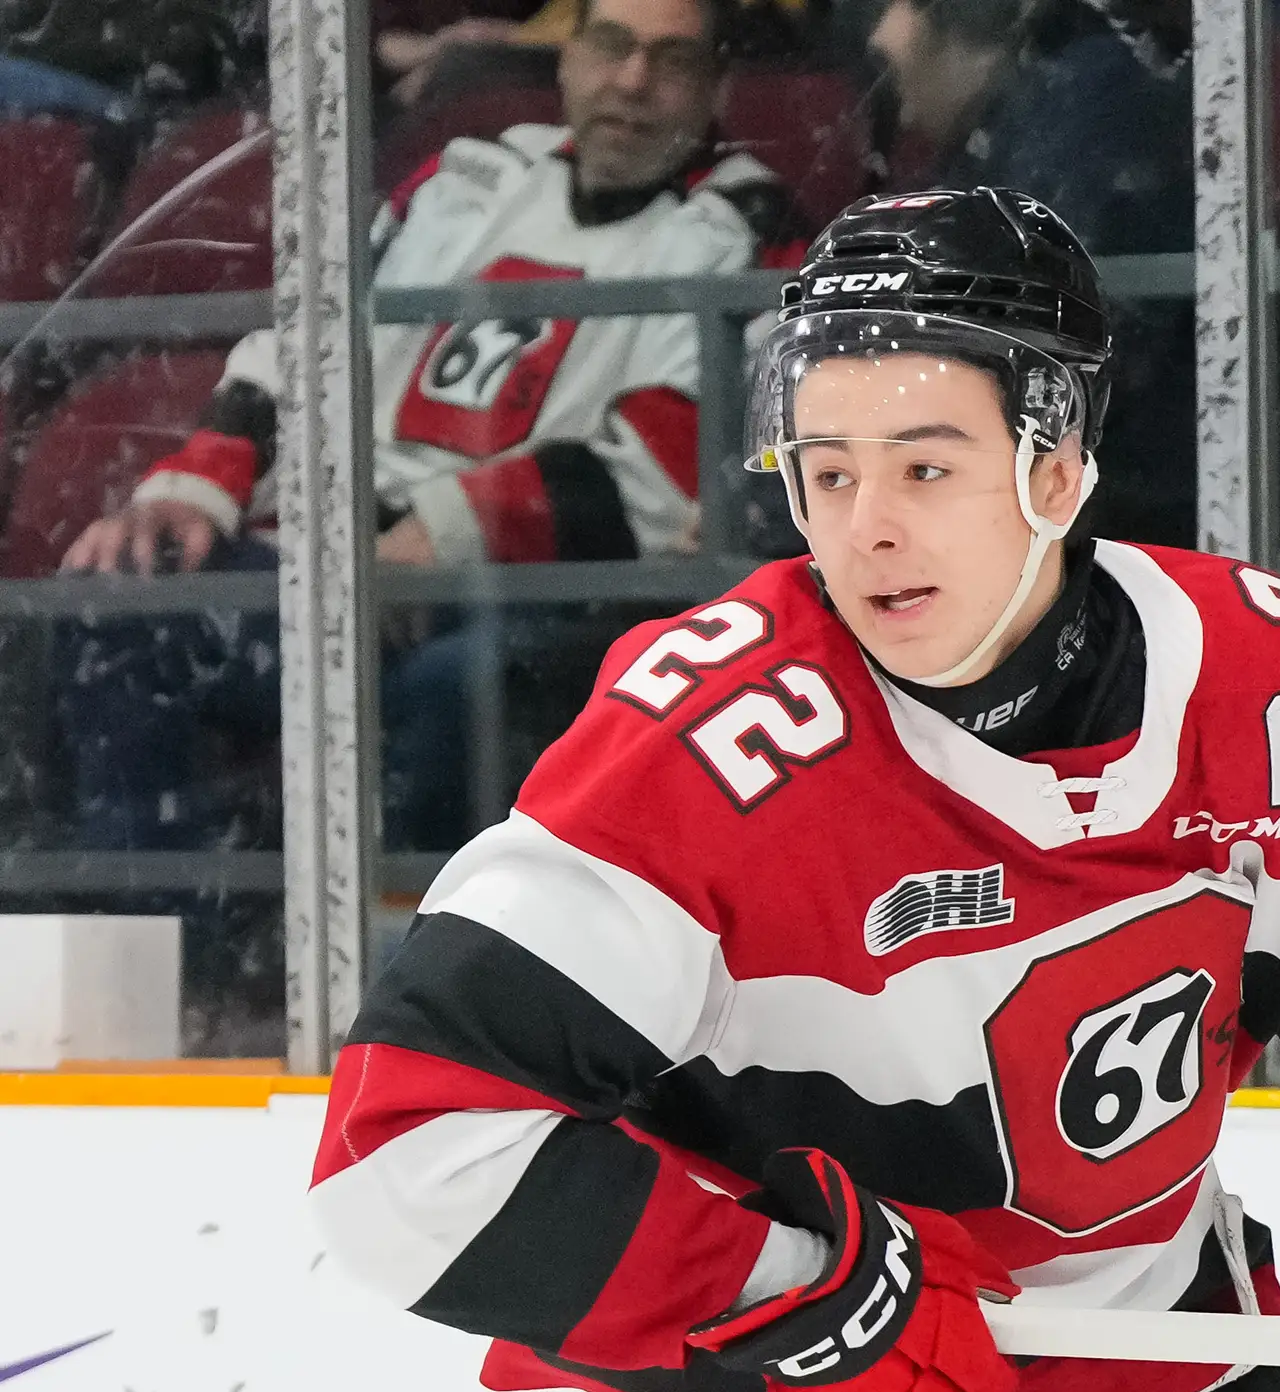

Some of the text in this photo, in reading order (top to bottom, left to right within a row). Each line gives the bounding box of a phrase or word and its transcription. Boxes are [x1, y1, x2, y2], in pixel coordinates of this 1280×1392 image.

[812, 272, 909, 296] CCM
[1032, 433, 1057, 450] CCM
[606, 598, 851, 816] 22
[864, 867, 1015, 955] OHL
[777, 1200, 915, 1378] CCM
